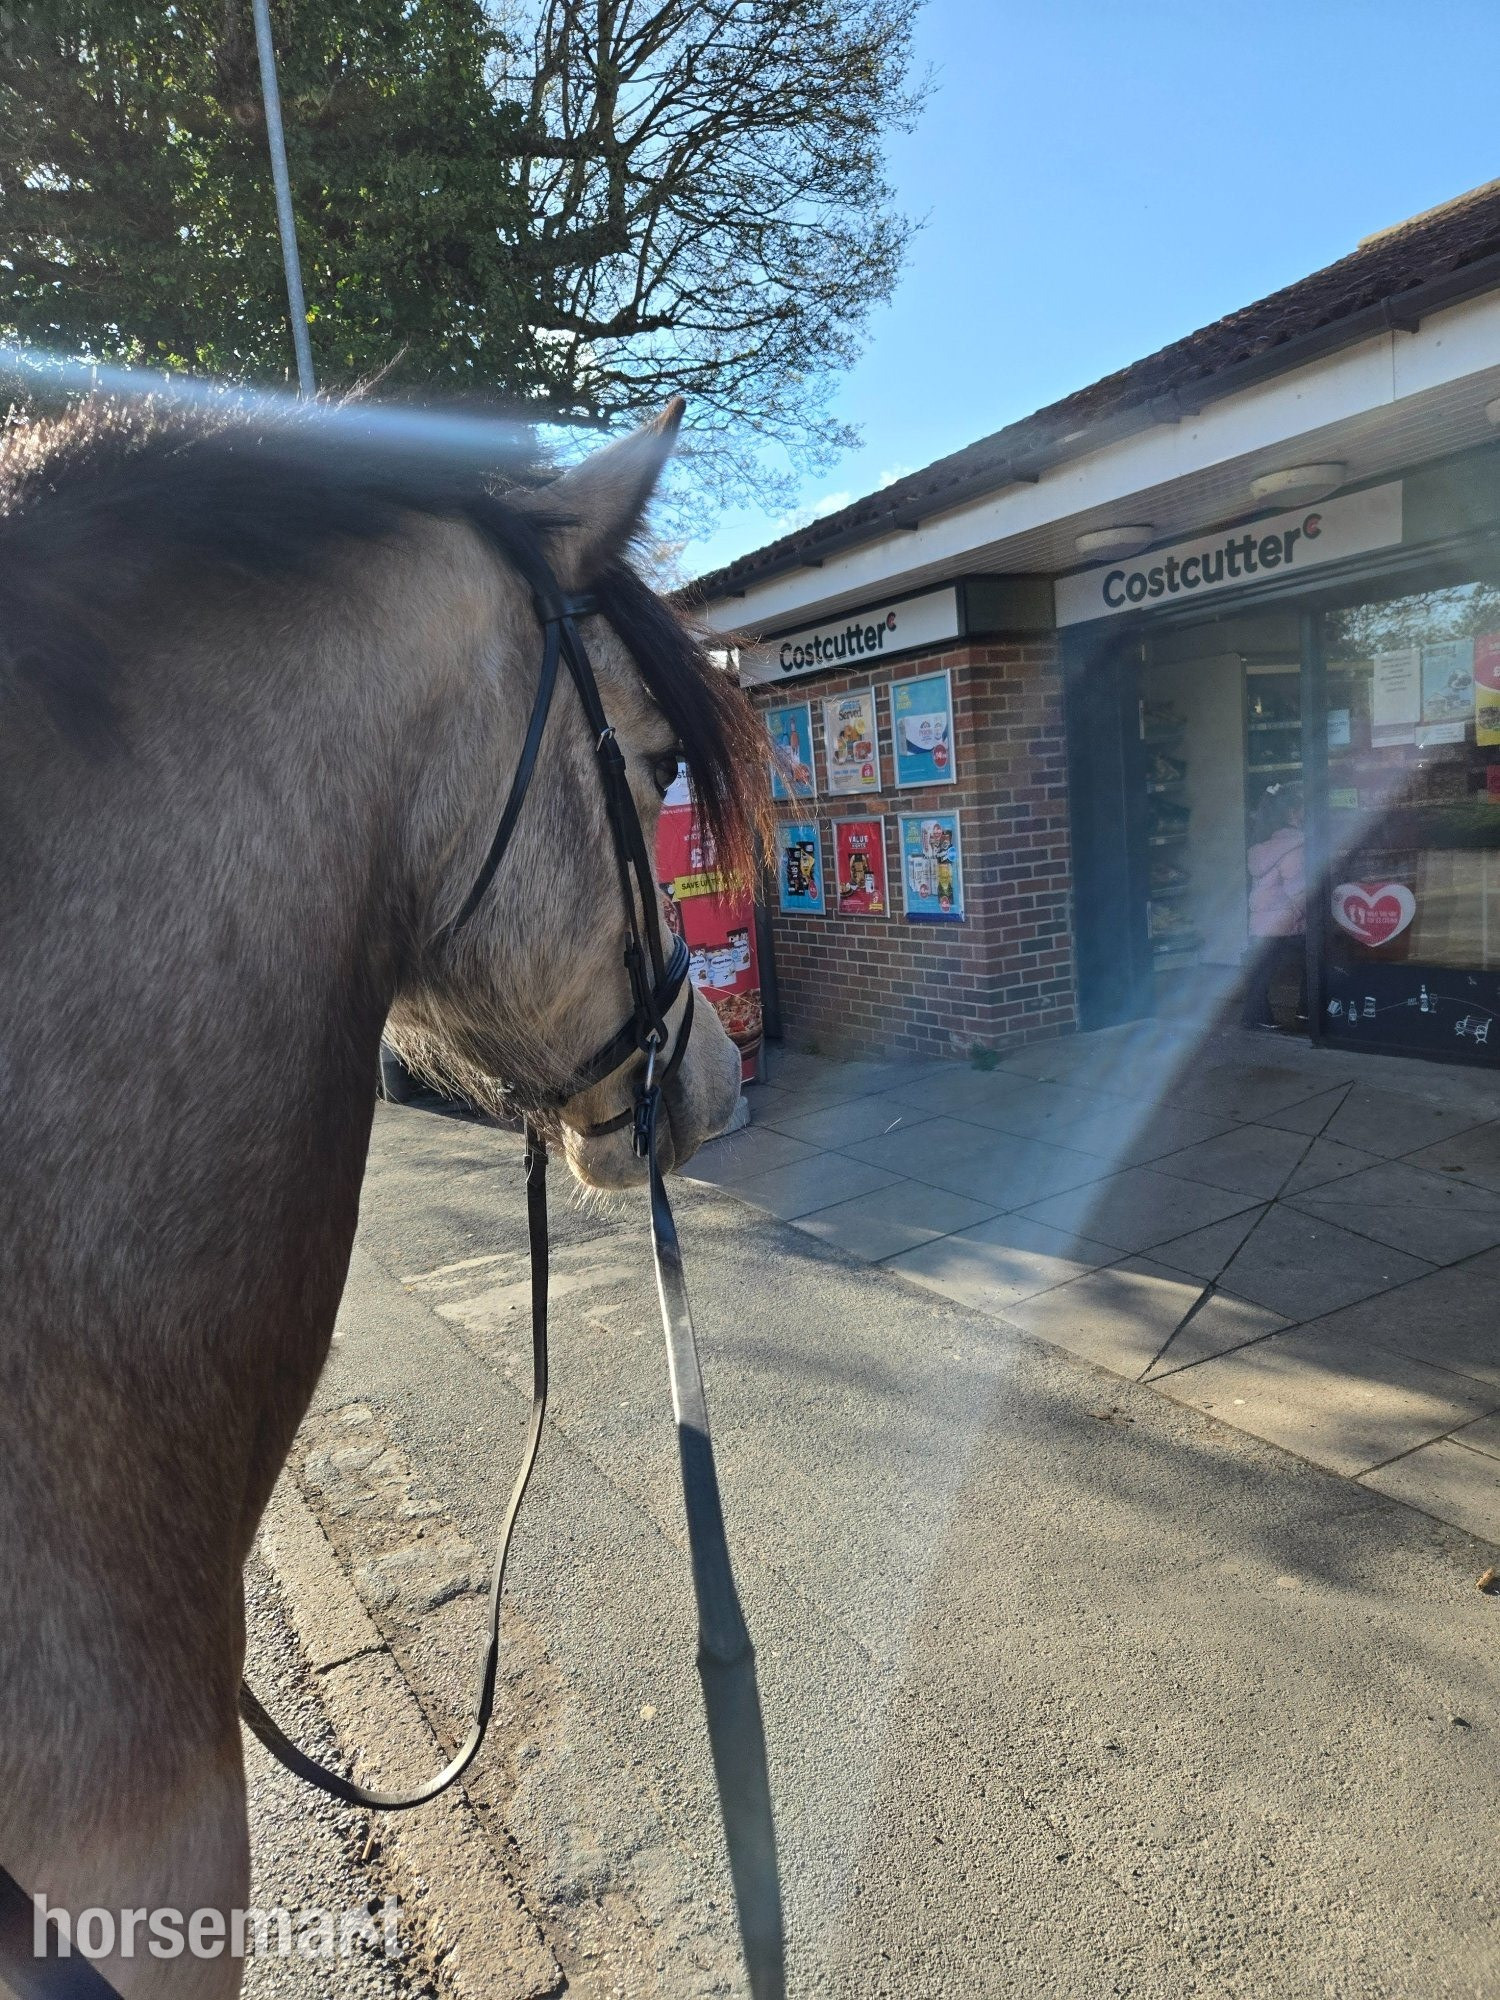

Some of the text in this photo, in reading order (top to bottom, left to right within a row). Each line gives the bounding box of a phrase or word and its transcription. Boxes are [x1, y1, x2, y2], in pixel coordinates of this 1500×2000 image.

[1102, 527, 1301, 608] Costcutter
[779, 621, 887, 673] Costcutter
[681, 881, 700, 891] SAVE
